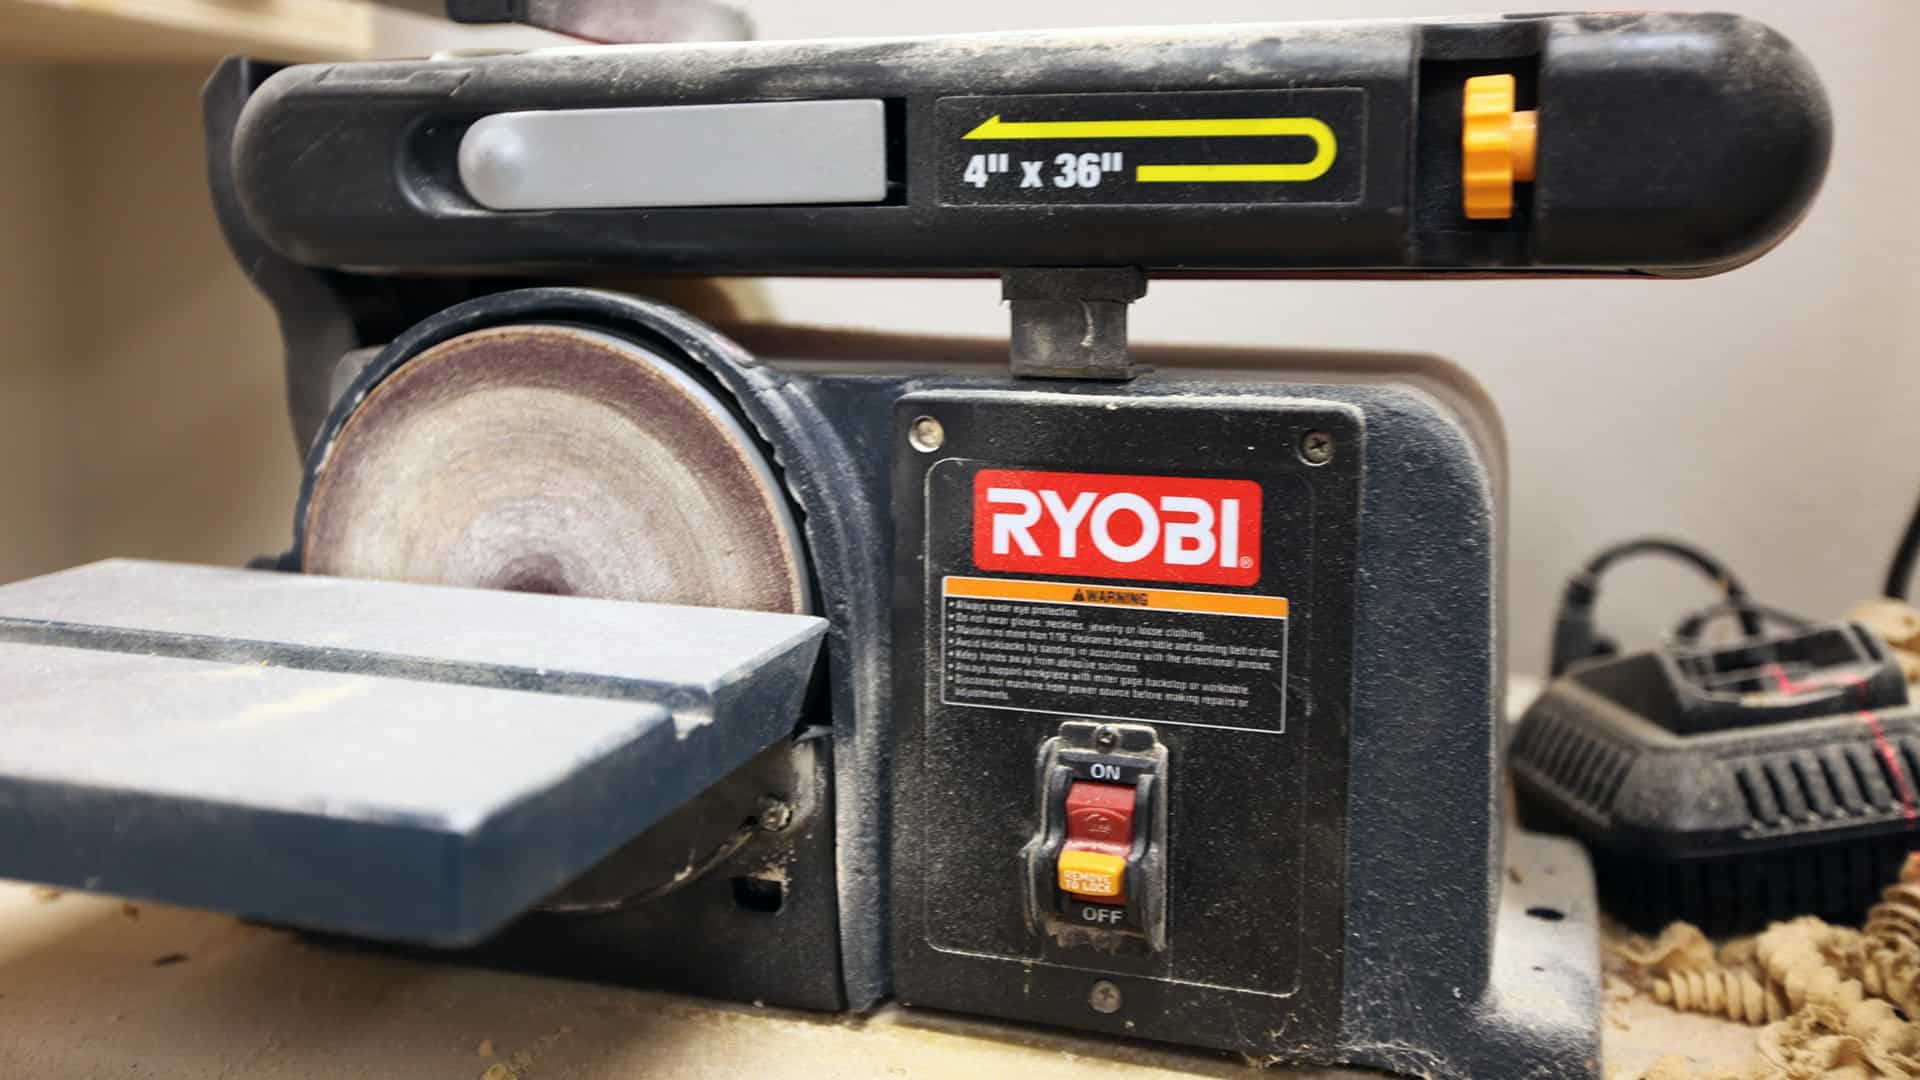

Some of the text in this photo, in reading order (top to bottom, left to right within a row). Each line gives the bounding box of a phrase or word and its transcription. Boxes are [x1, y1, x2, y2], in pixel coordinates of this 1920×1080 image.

[963, 152, 1123, 188] 4" x 36"
[987, 487, 1240, 568] RYOBI
[1086, 589, 1149, 606] WARNING
[955, 600, 987, 613] Always
[989, 604, 1012, 612] wear
[1013, 606, 1030, 615] eye
[955, 612, 969, 622] Do
[970, 614, 985, 623] not
[986, 616, 1008, 625] wear
[1125, 626, 1136, 634] or
[1137, 625, 1163, 636] loose
[1027, 643, 1038, 654] by
[1039, 645, 1076, 657] sanding
[1143, 652, 1164, 662] with
[1165, 653, 1182, 663] the
[1151, 640, 1173, 650] table
[1174, 642, 1192, 651] and
[1248, 648, 1258, 656] or
[1008, 655, 1032, 666] away
[1070, 672, 1091, 682] with
[1188, 682, 1200, 690] or
[1068, 685, 1097, 696] power
[1090, 763, 1121, 780] ON
[1064, 870, 1112, 885] REMOVE
[1065, 879, 1112, 893] TO LOCK
[1082, 907, 1124, 924] OFF
